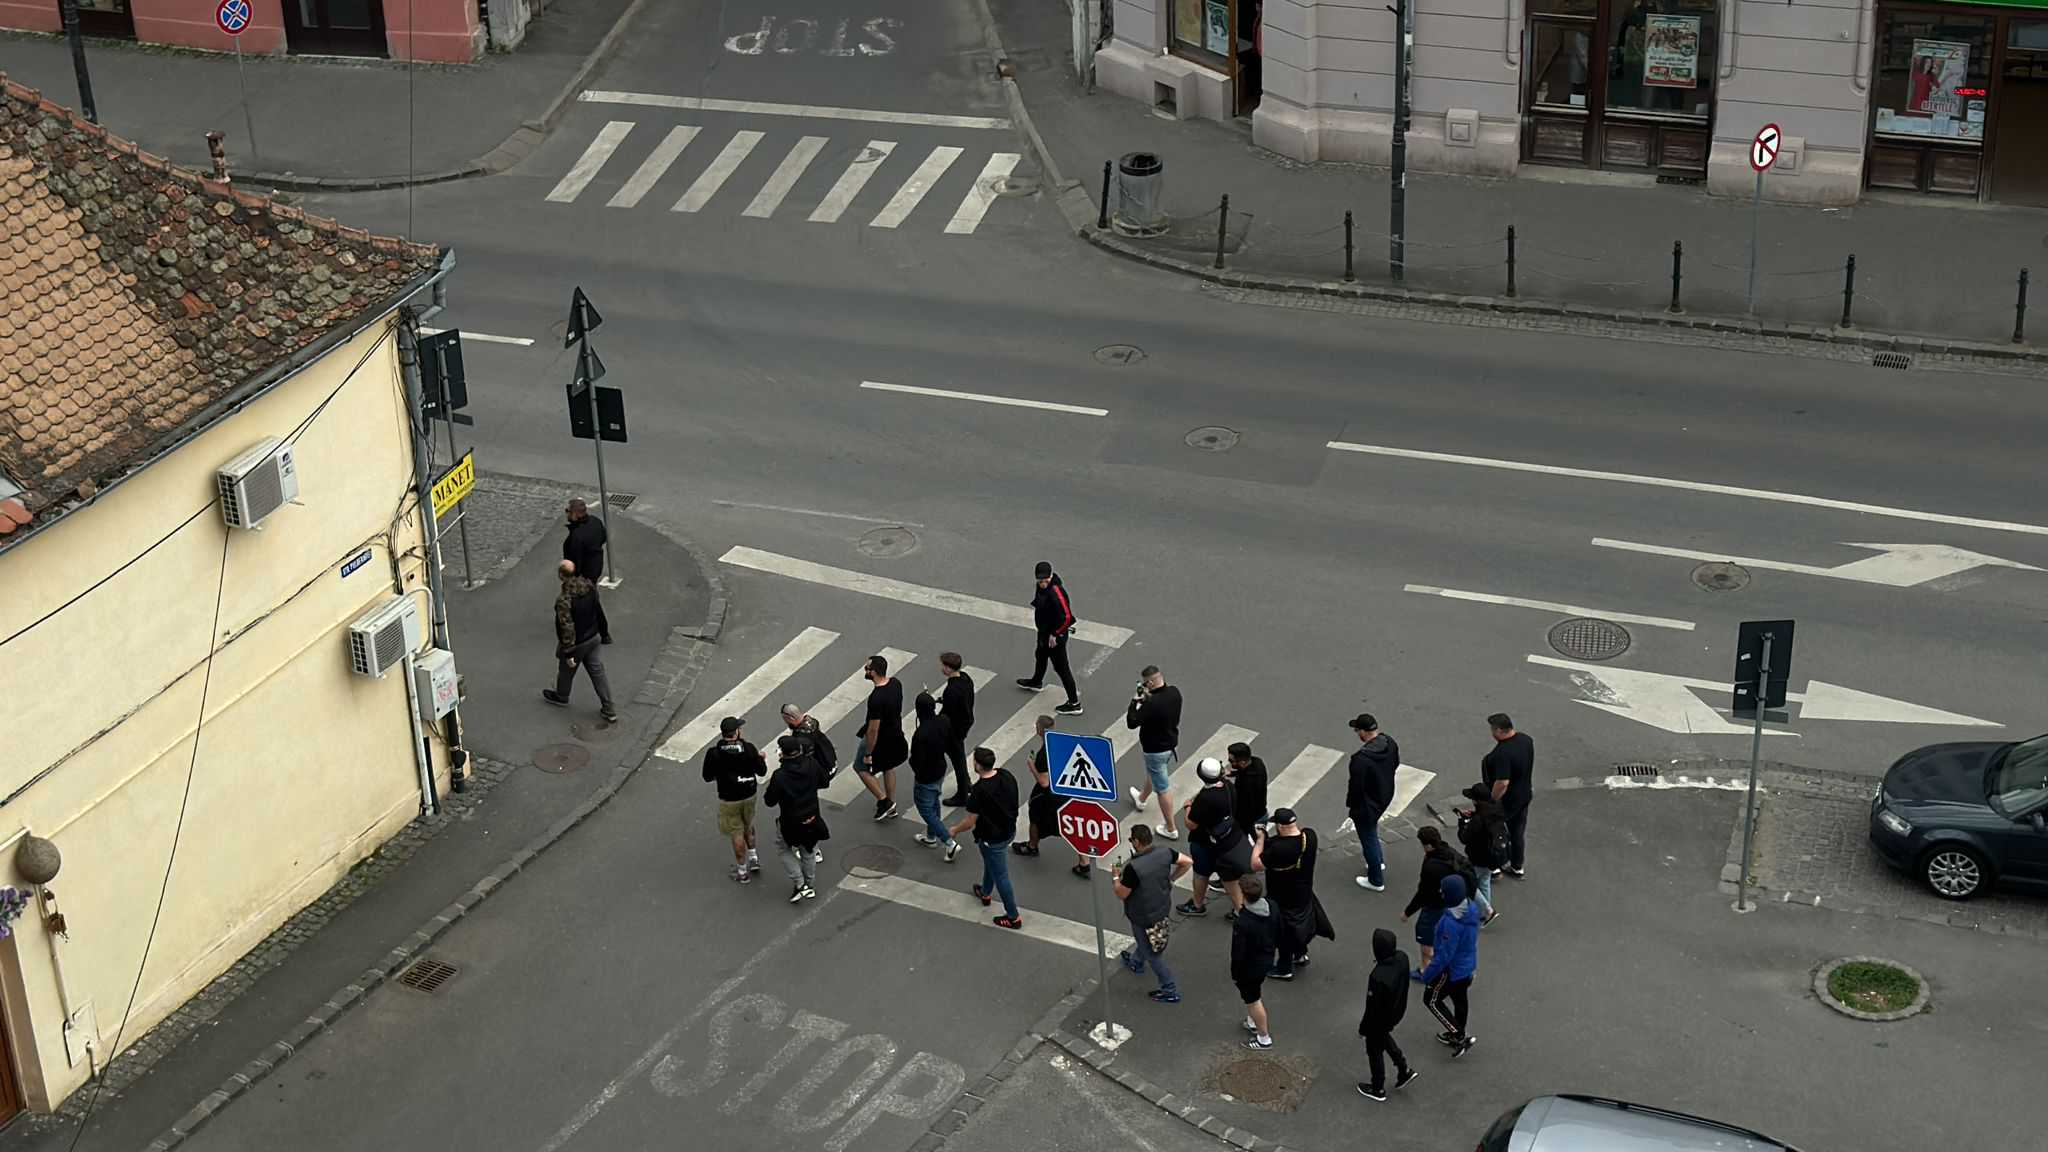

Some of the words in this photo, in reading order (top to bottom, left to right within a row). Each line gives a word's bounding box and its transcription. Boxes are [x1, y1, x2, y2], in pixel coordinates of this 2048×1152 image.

[724, 16, 904, 56] STOP
[1062, 814, 1115, 841] STOP
[650, 993, 966, 1151] STOP
